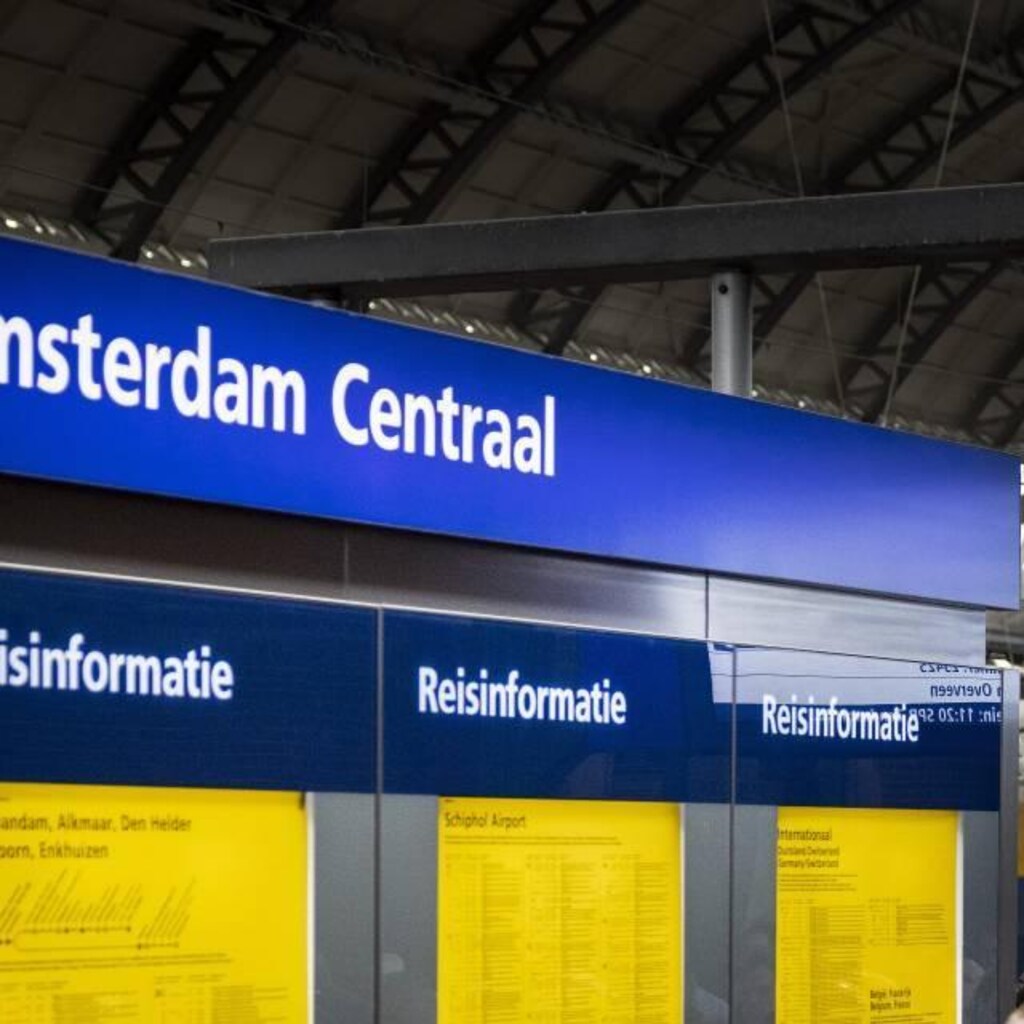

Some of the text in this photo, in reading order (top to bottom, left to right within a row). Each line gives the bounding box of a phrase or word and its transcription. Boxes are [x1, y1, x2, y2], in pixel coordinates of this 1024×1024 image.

[332, 362, 556, 476] Centraal
[417, 665, 628, 725] Reisinformatie
[761, 693, 920, 742] Reisinformatie
[120, 813, 147, 832] Den
[150, 815, 193, 832] Helder
[445, 812, 526, 829] Schiphol Airport
[38, 841, 109, 858] Enkhuizen
